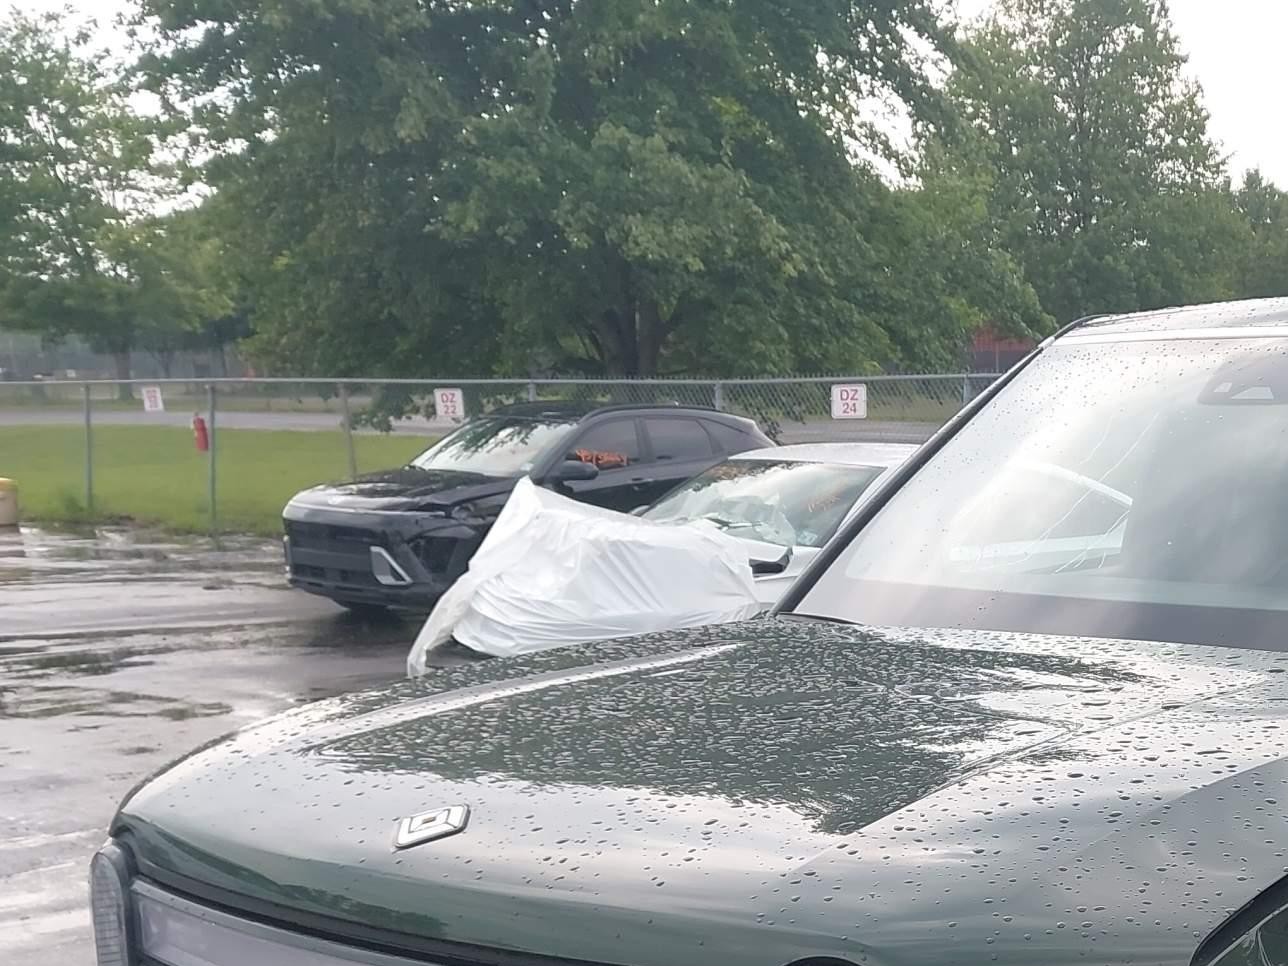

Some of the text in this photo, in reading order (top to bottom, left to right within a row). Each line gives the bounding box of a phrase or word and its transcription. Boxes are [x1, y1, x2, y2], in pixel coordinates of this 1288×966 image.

[441, 392, 456, 403] DZ
[840, 389, 858, 401] DZ
[842, 402, 857, 414] 24
